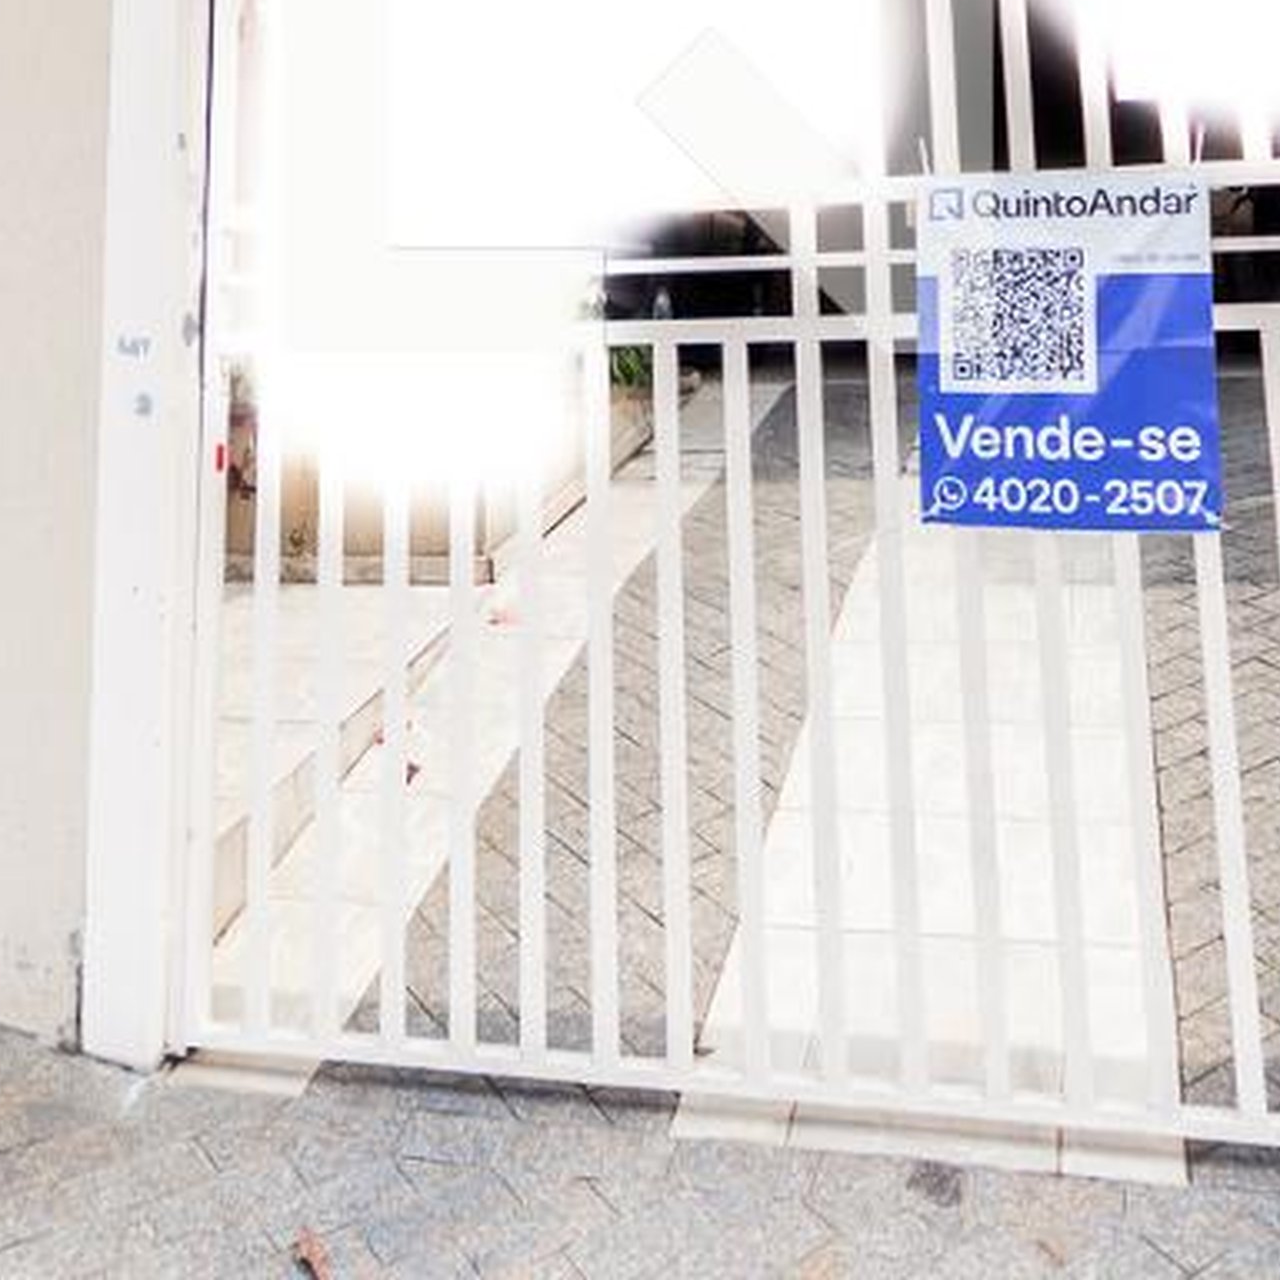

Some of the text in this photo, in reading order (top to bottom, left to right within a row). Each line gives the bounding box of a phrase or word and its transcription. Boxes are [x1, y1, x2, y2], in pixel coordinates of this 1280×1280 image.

[972, 187, 1198, 219] QuintoAndar
[934, 414, 1201, 461] Vende-se
[973, 478, 1209, 516] 4020-2507
